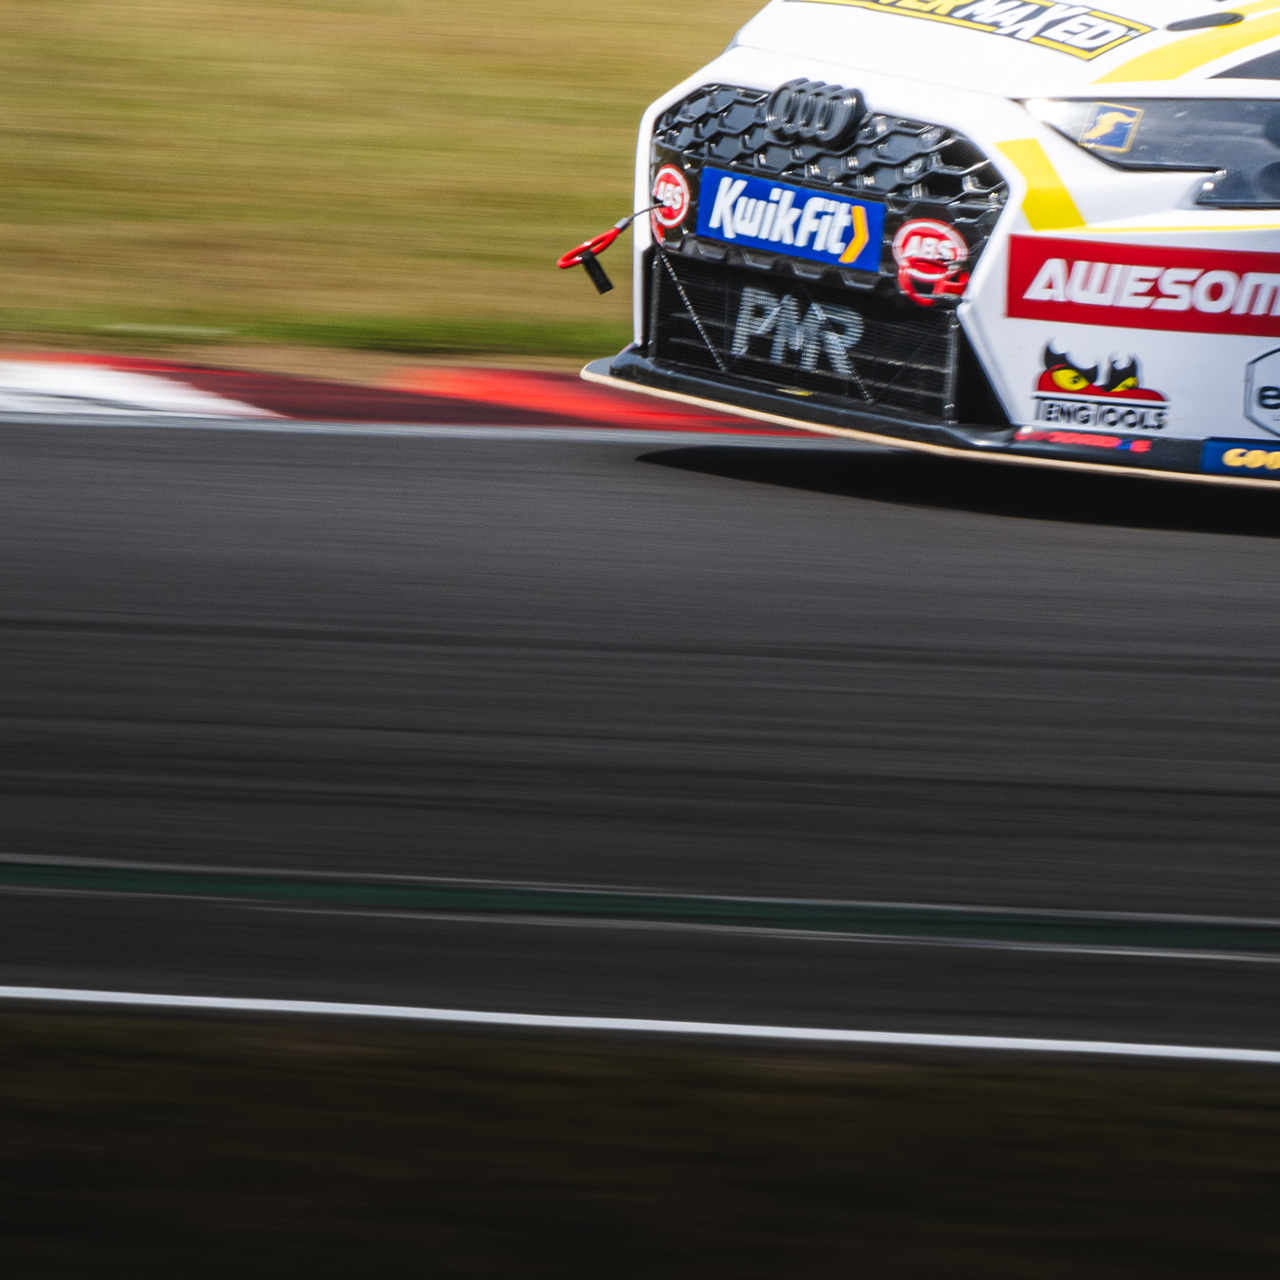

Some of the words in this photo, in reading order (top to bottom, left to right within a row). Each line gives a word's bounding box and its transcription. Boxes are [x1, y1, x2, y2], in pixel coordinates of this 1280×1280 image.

[655, 186, 682, 210] ABS
[903, 234, 954, 262] ABS
[731, 287, 864, 377] PMR
